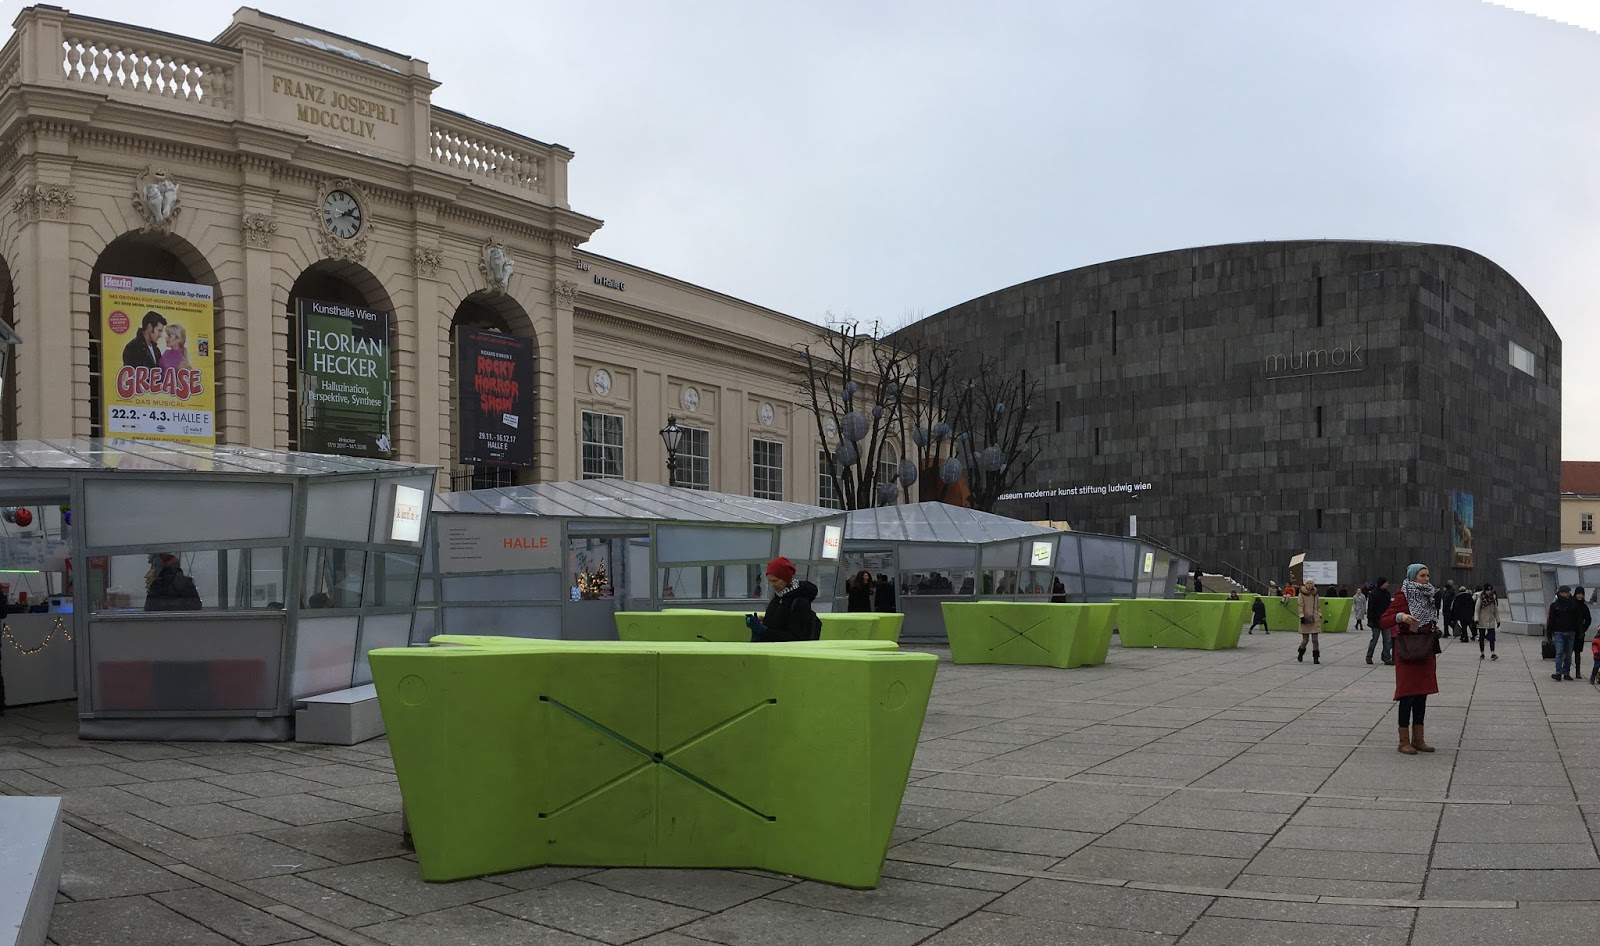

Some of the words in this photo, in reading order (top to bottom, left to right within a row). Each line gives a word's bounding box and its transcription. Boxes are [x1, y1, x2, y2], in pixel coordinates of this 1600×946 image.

[272, 74, 326, 105] FRANZ
[296, 103, 376, 140] MDCCCLIV.
[105, 276, 132, 288] Heute
[134, 286, 159, 294] präsentiert
[312, 302, 354, 318] Kunsthalle
[356, 308, 376, 321] Wien
[308, 329, 382, 357] FLORIAN
[314, 352, 378, 379] HECKER
[477, 355, 516, 376] ROCKY
[1265, 340, 1362, 372] mumok
[116, 365, 204, 400] GREASE
[322, 380, 369, 395] Halluzination,
[474, 374, 519, 399] HORROR
[308, 390, 350, 404] Perspektive,
[352, 394, 382, 406] Synthese
[480, 393, 513, 413] SHOW
[112, 408, 140, 420] 22.2.
[149, 410, 170, 422] 4.3.
[172, 412, 201, 424] HALLE
[203, 414, 209, 424] E
[488, 441, 504, 450] HALLE
[1058, 486, 1078, 496] kunst
[1078, 483, 1107, 494] stiftung
[1108, 482, 1133, 493] ludwig
[1134, 481, 1152, 490] wien
[503, 537, 548, 548] HALLE
